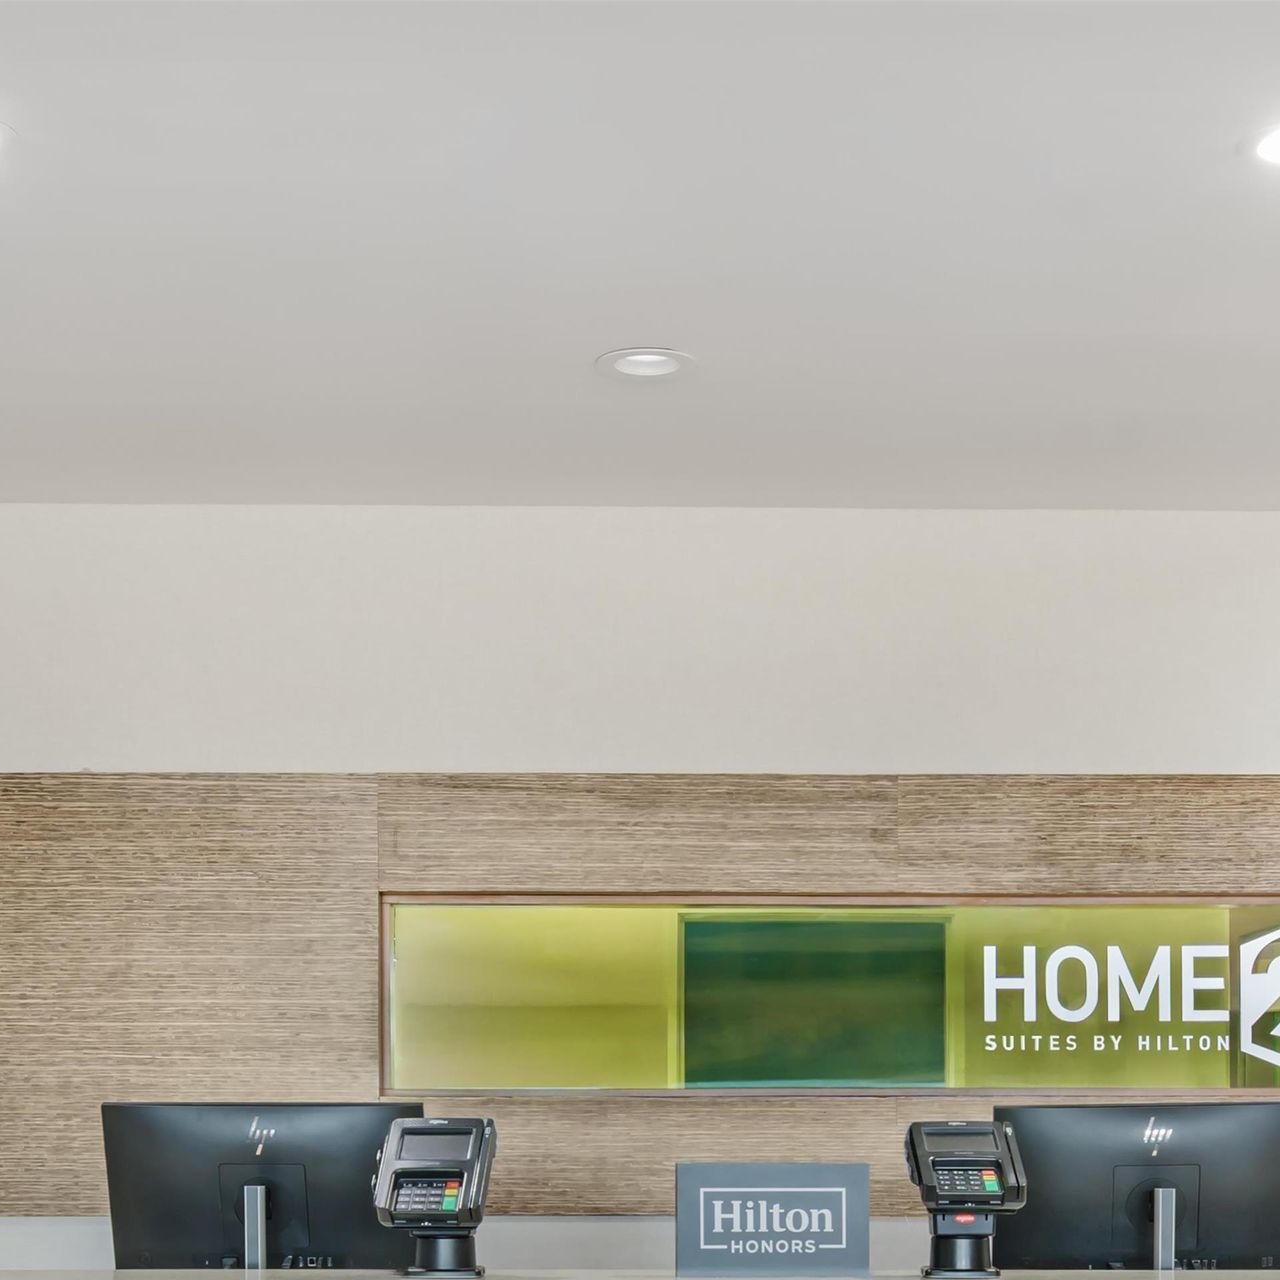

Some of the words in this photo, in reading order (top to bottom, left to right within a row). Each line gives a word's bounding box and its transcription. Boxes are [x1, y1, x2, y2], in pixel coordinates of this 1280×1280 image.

[984, 1034, 1078, 1052] SUITES
[1093, 1034, 1123, 1052] BY
[1137, 1034, 1231, 1052] HILTON
[248, 1116, 276, 1156] hp
[1143, 1116, 1174, 1157] hp
[712, 1200, 834, 1234] Hilton
[730, 1239, 817, 1254] HONORS
